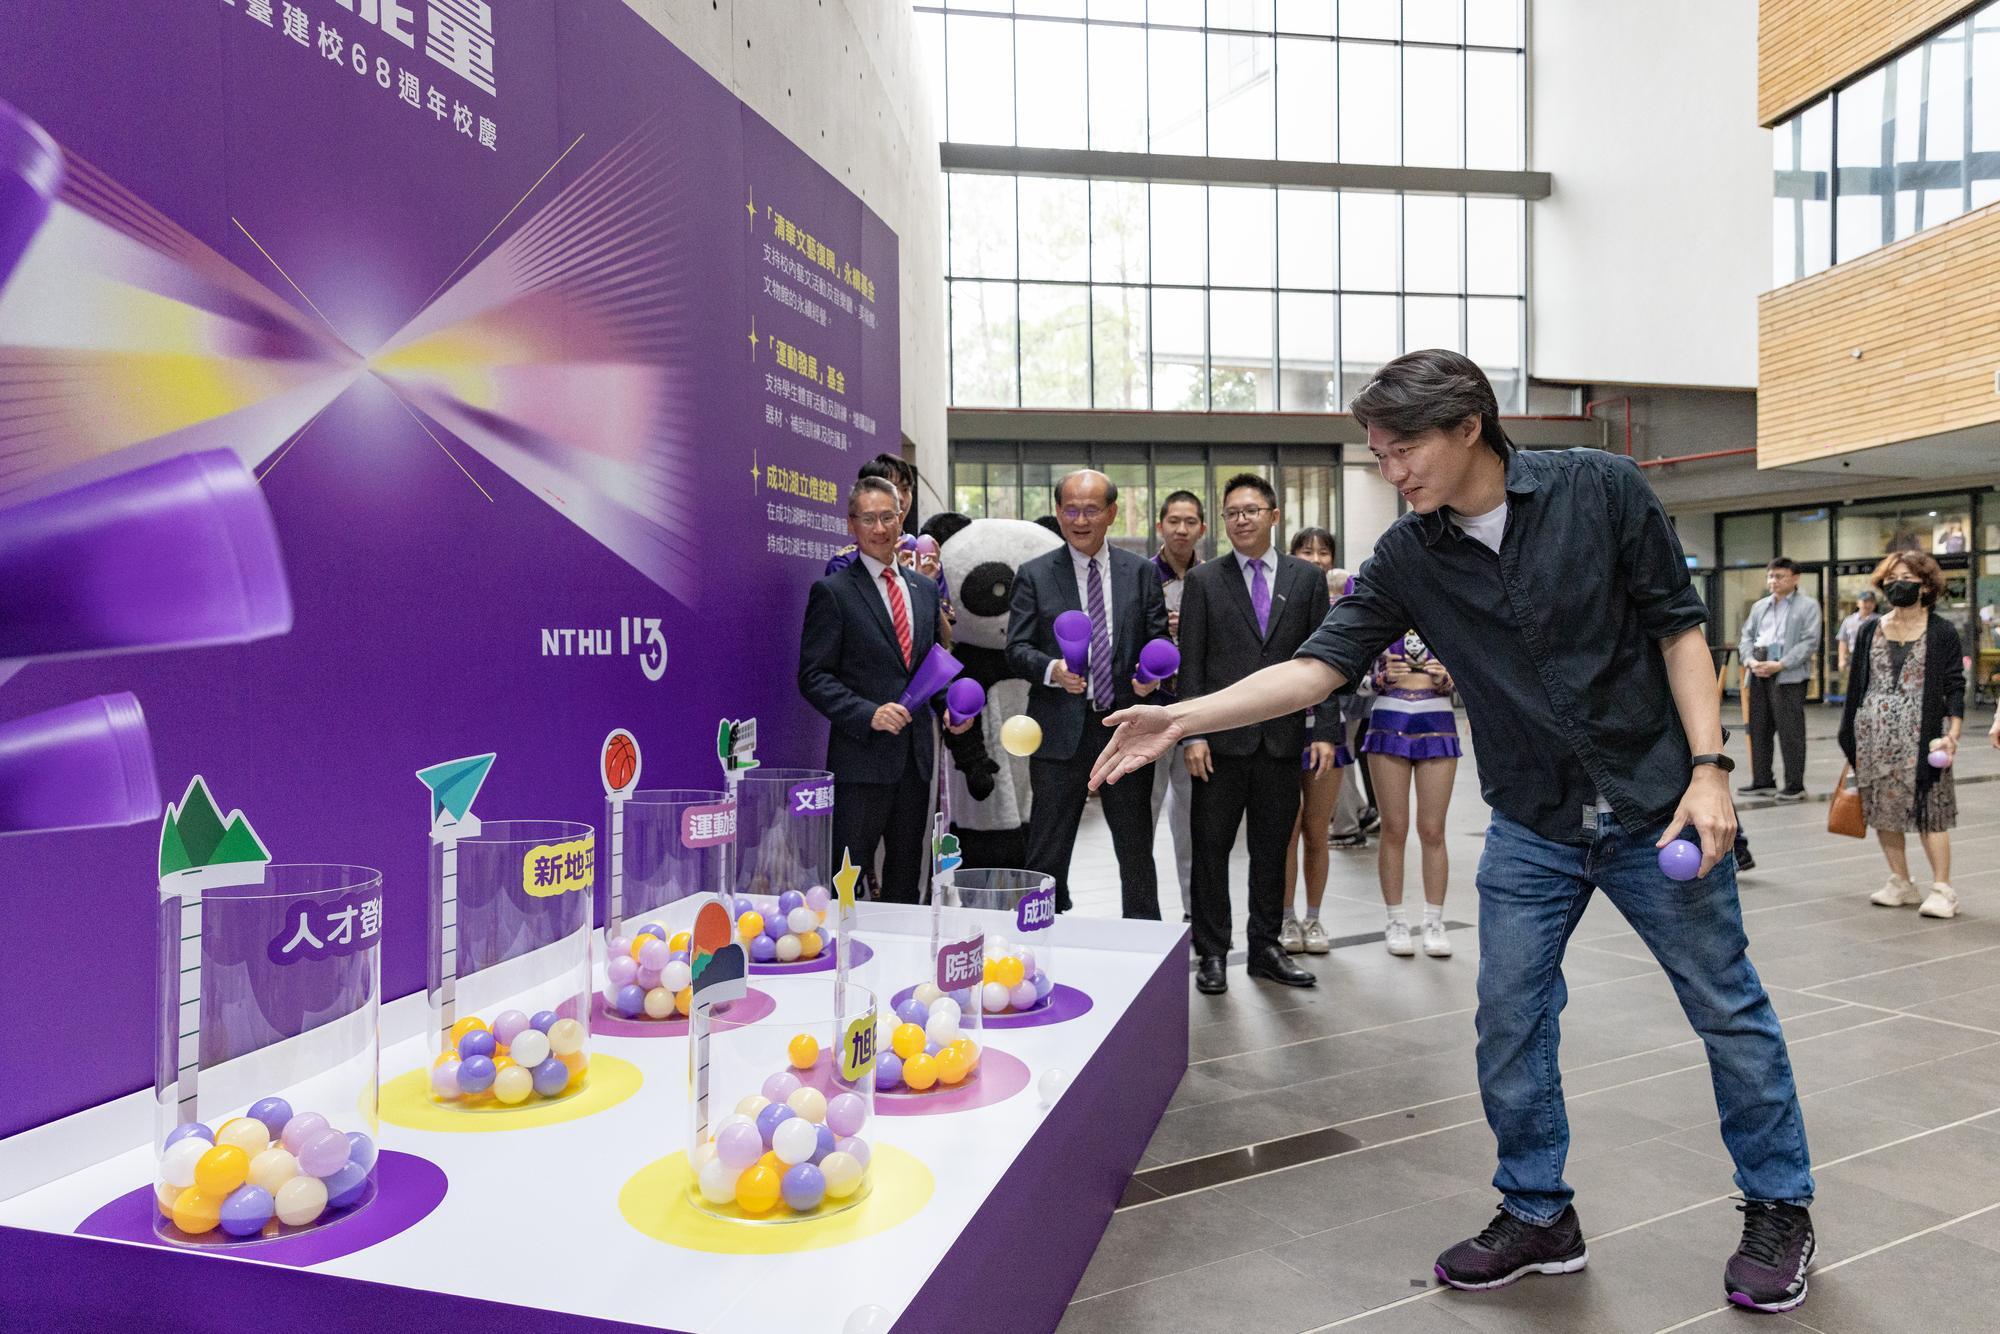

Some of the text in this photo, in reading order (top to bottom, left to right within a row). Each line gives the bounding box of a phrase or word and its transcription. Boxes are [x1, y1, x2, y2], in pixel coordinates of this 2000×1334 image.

[224, 0, 497, 151] 臺建校68週年校慶
[541, 616, 668, 681] NTHU 113
[282, 896, 382, 953] 人才登
